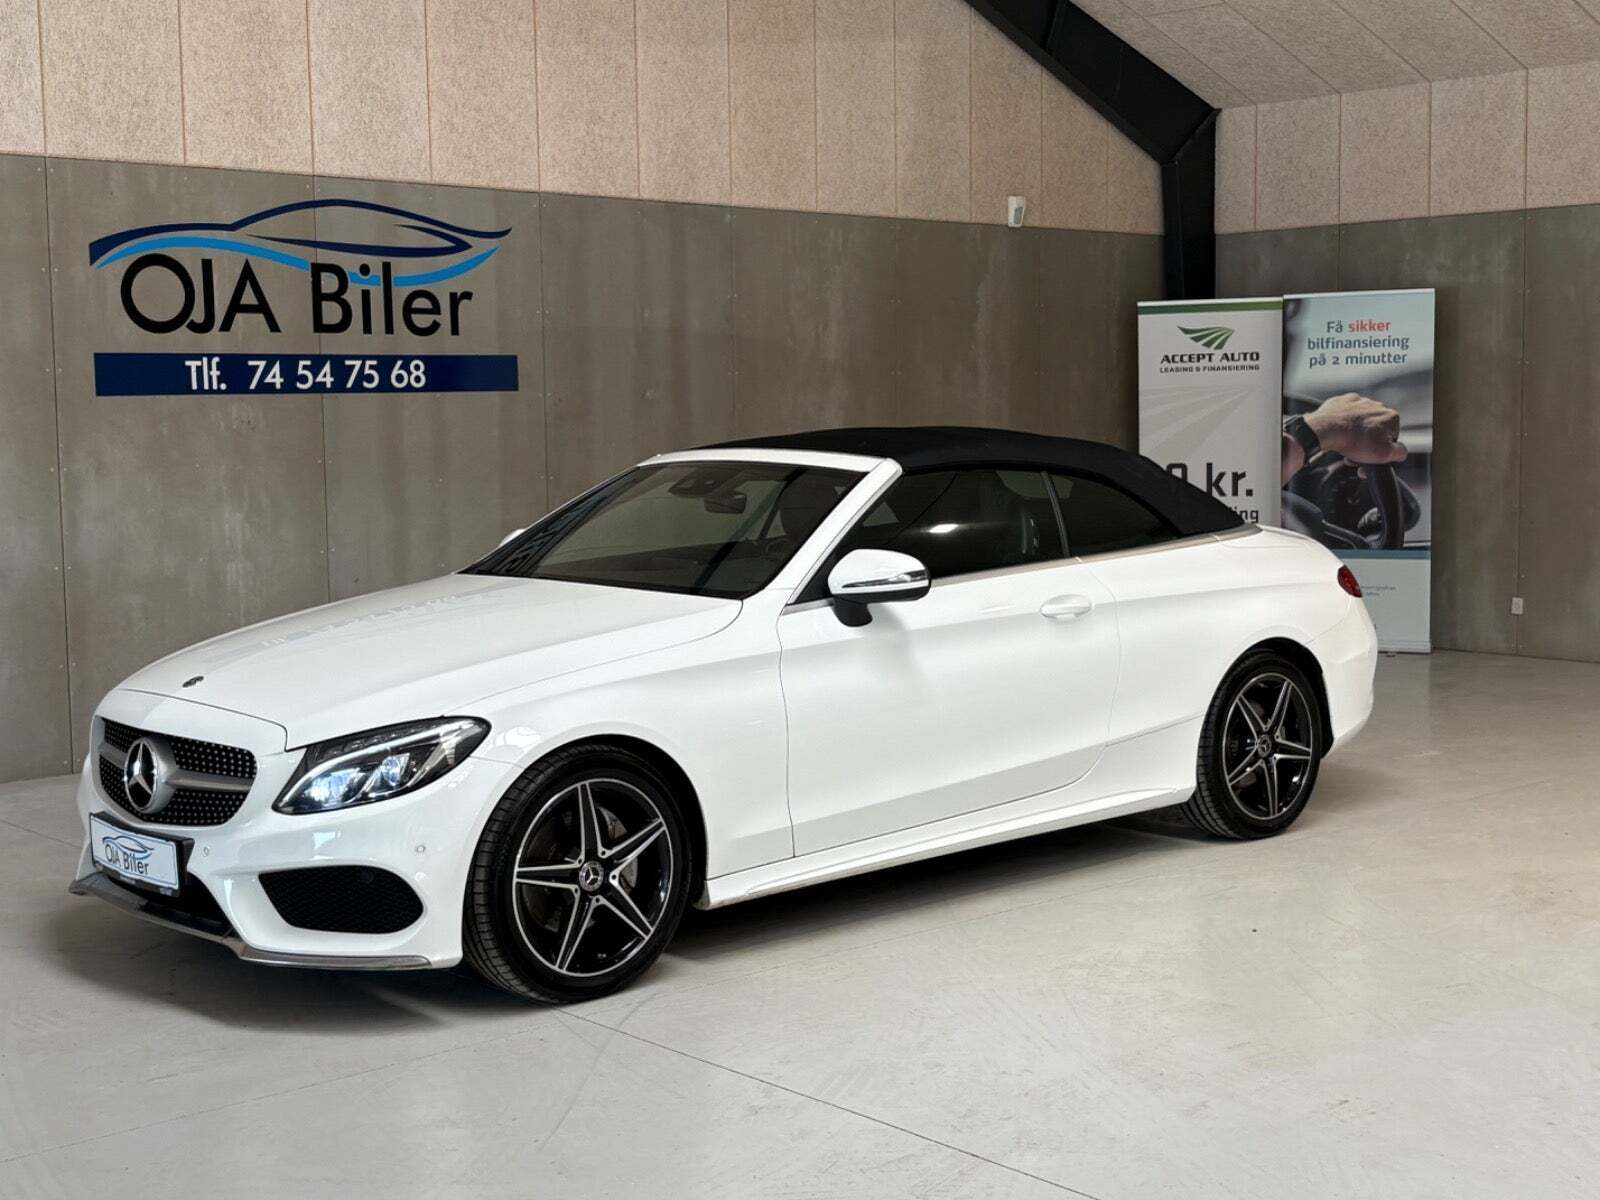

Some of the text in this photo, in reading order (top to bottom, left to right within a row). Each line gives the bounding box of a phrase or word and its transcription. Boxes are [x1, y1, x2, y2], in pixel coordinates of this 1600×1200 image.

[120, 252, 473, 336] OJA Biler
[1326, 319, 1392, 333] Få sikker
[1307, 335, 1410, 350] bilfinansiering
[1160, 351, 1260, 364] ACCEPT AUTO
[1309, 352, 1408, 369] på 2 minutter
[185, 357, 426, 390] Tlf. 74 54 75 68
[1203, 364, 1260, 372] FINANSIERING
[1206, 462, 1254, 497] kr.
[123, 851, 149, 875] Biler
